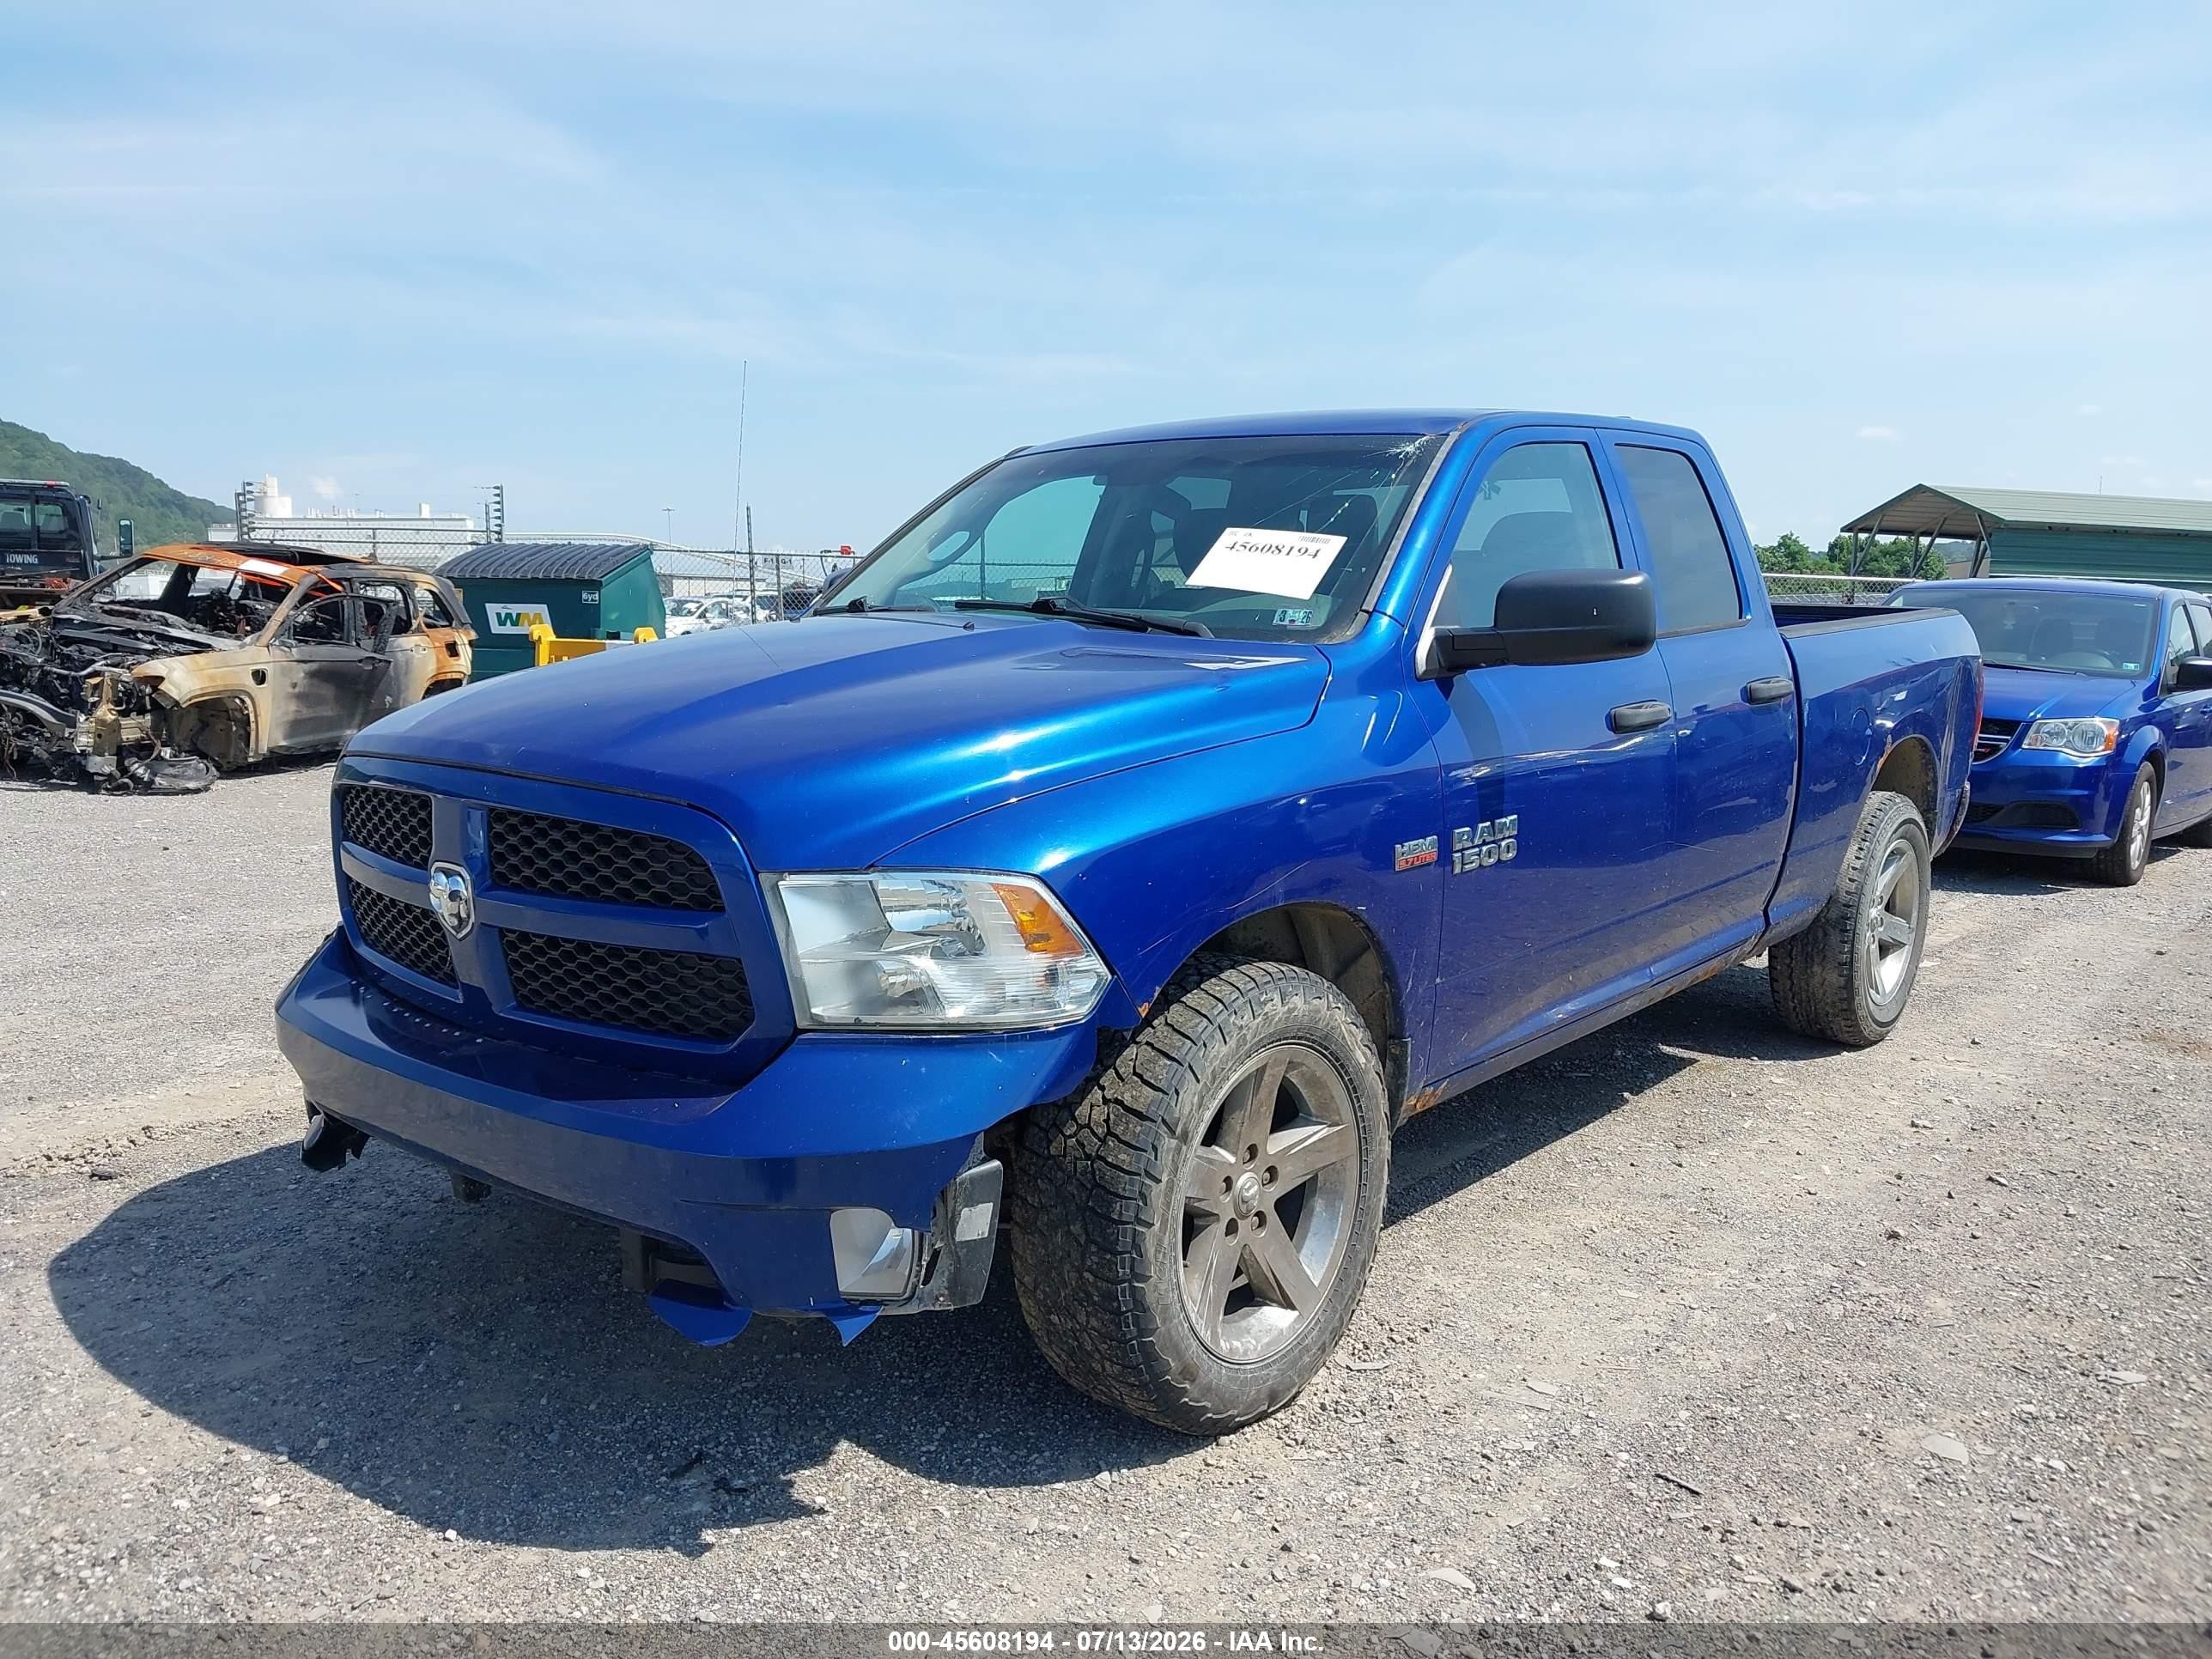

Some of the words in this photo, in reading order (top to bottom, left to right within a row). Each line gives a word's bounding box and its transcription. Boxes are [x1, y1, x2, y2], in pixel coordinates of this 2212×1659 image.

[1224, 540, 1322, 559] 45608194
[495, 611, 544, 627] WM
[1452, 814, 1518, 851] RAM
[1413, 852, 1437, 865] LITER
[1451, 837, 1517, 875] 1500
